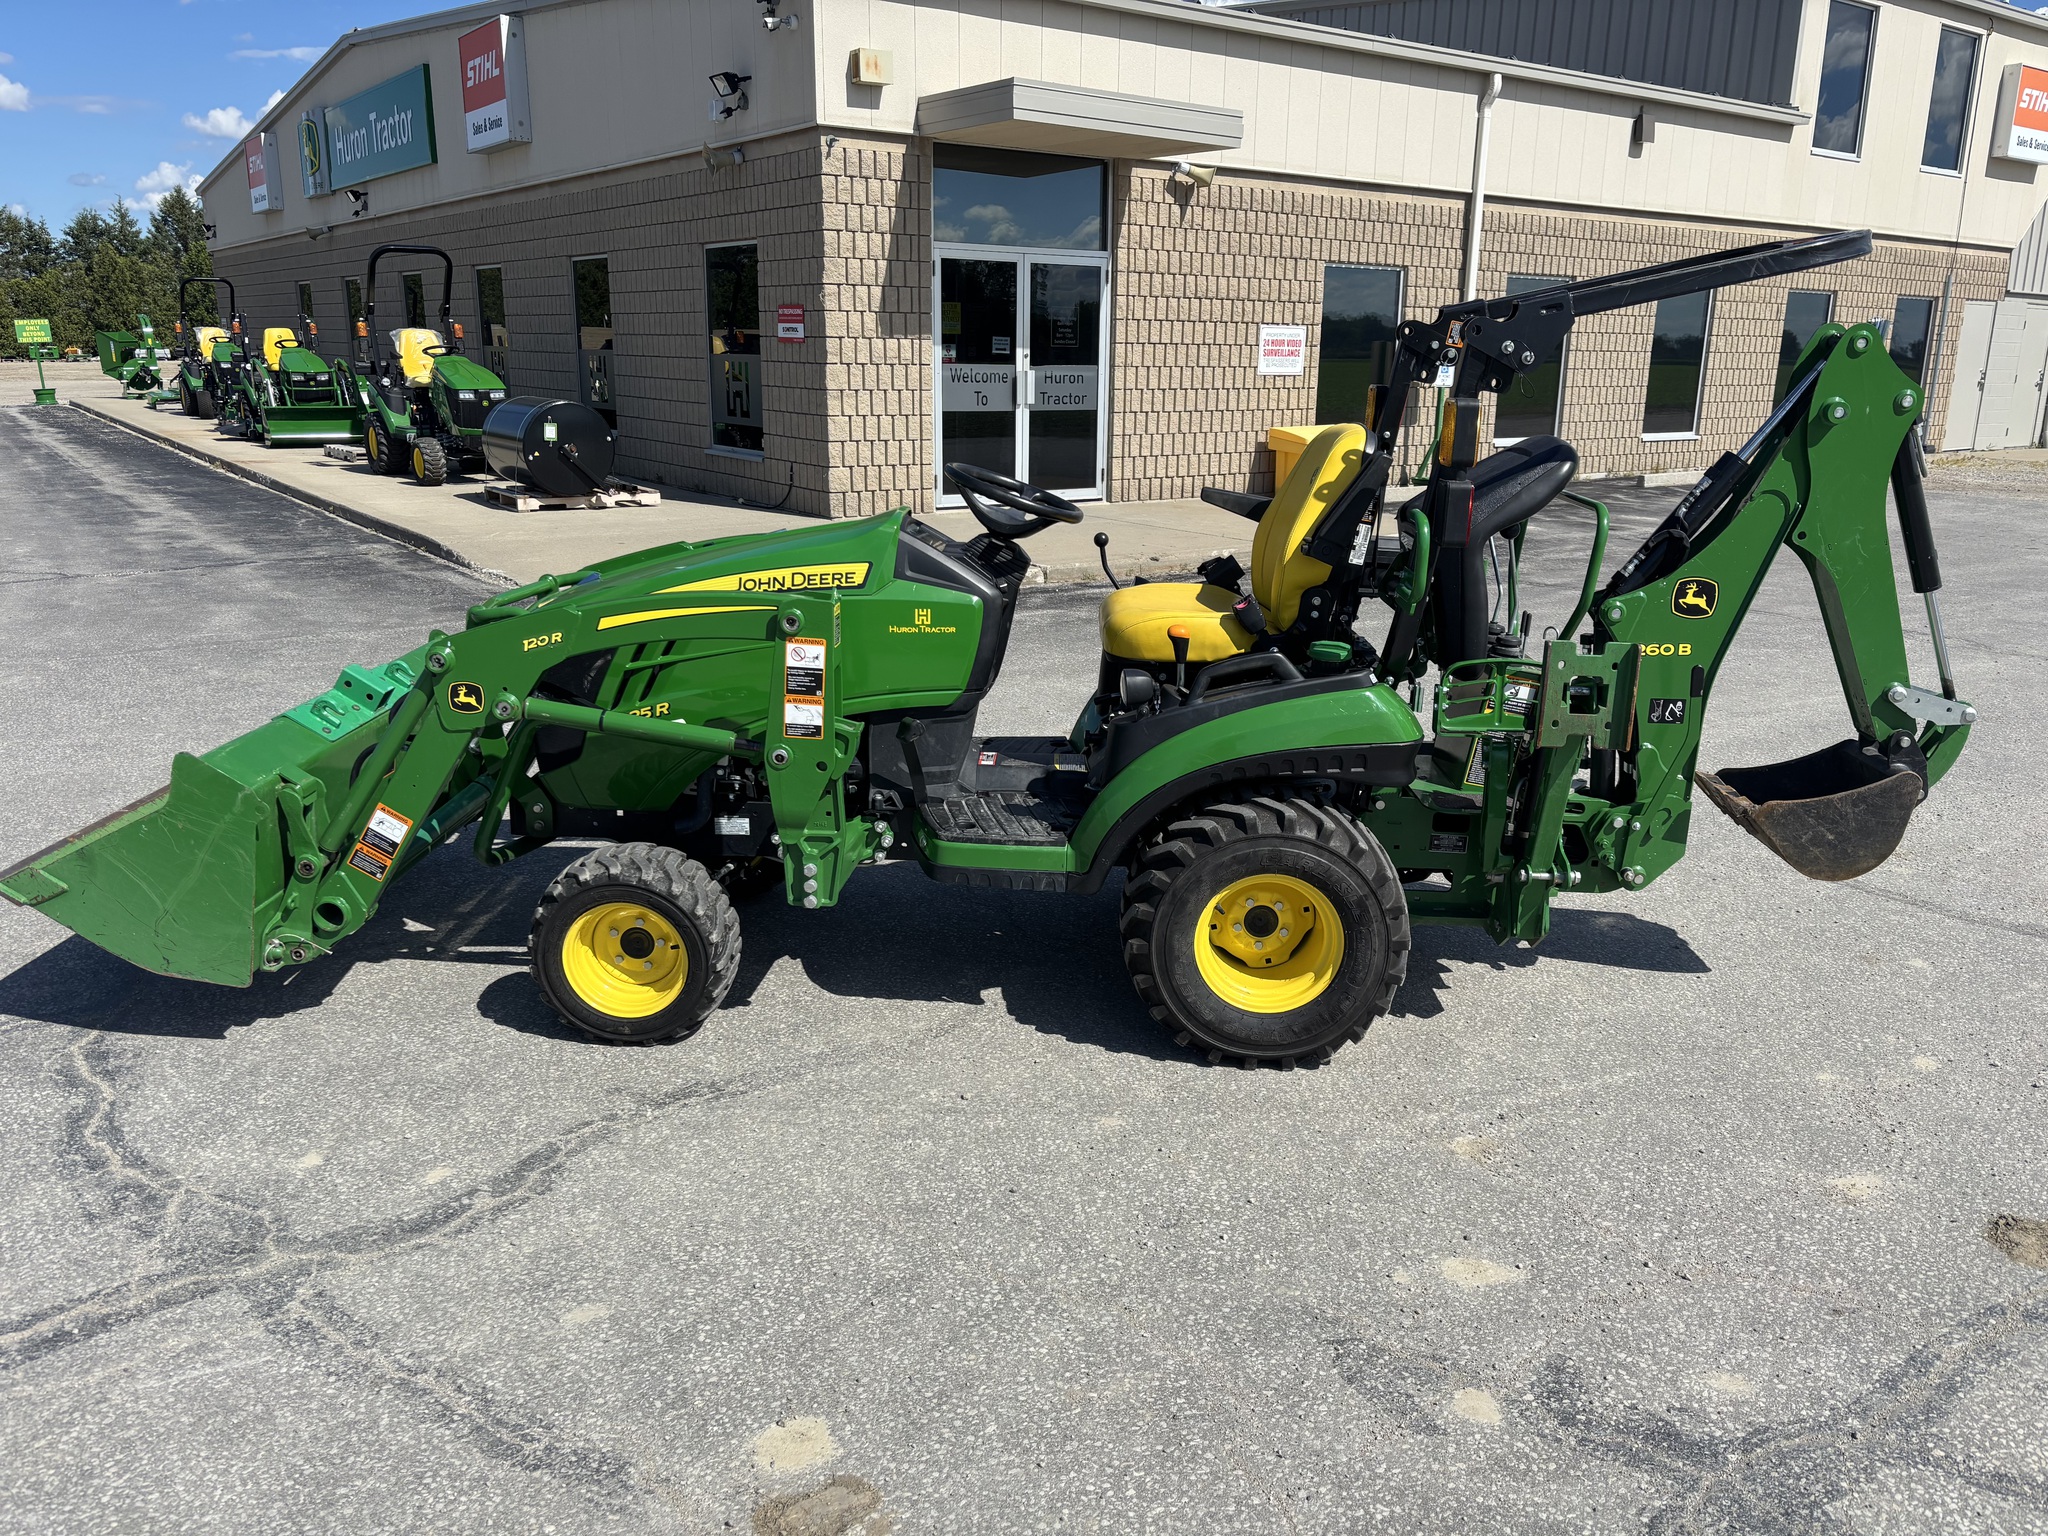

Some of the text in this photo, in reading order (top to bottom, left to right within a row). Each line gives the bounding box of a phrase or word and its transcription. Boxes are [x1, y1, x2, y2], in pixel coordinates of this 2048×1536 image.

[466, 49, 500, 88] STIHL
[472, 115, 503, 136] Sales & Service
[334, 104, 413, 166] Huron Tractor
[2016, 135, 2029, 148] Sales
[2029, 137, 2034, 149] &
[1263, 339, 1302, 347] 24 HOUR VIDEO
[1263, 349, 1300, 357] SURVEILLANCE
[950, 368, 1009, 384] Welcome
[1044, 370, 1084, 384] Huron
[973, 391, 988, 406] To
[1040, 391, 1087, 405] Tractor
[737, 571, 856, 591] JOHN DEERE
[889, 625, 956, 633] HURON TRACTOR
[522, 632, 563, 652] 120 R
[793, 638, 824, 646] WARNING
[1678, 643, 1692, 656] B
[791, 697, 822, 705] WARNING
[656, 702, 670, 717] R
[386, 809, 409, 824] WARNING
[365, 849, 388, 864] WARNING
[1259, 850, 1370, 925] CARLISLE
